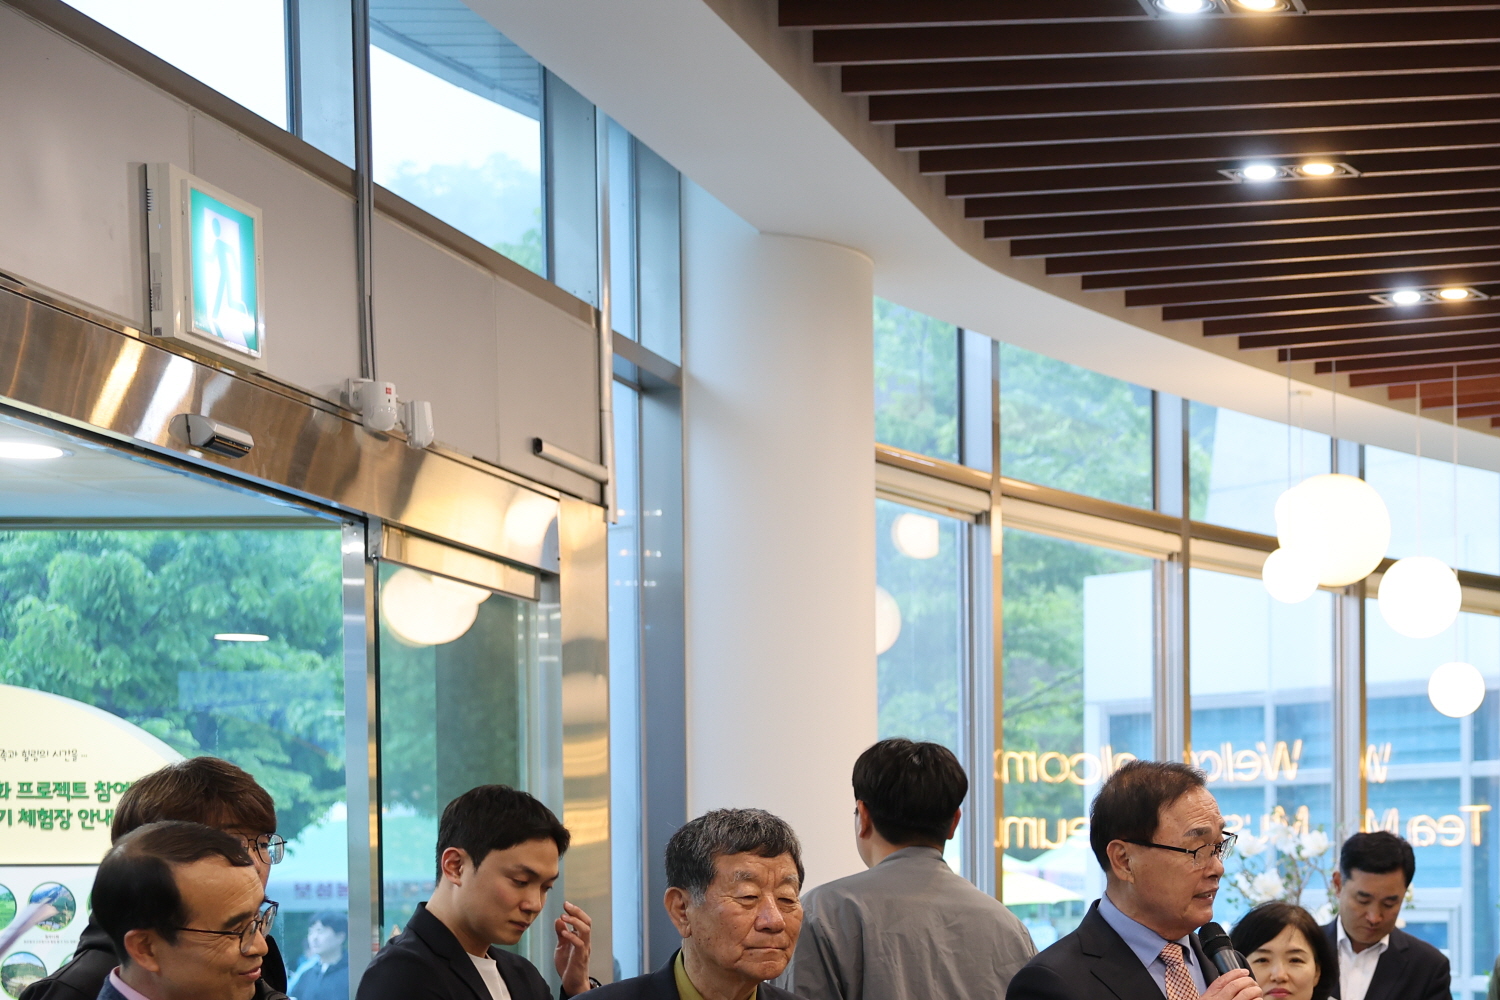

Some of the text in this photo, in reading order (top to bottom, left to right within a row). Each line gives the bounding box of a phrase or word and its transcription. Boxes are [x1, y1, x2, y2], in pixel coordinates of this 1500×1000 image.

[52, 748, 78, 762] 시간을
[16, 781, 90, 802] 프로젝트
[18, 808, 73, 831] 체험장
[77, 808, 115, 831] 안내
